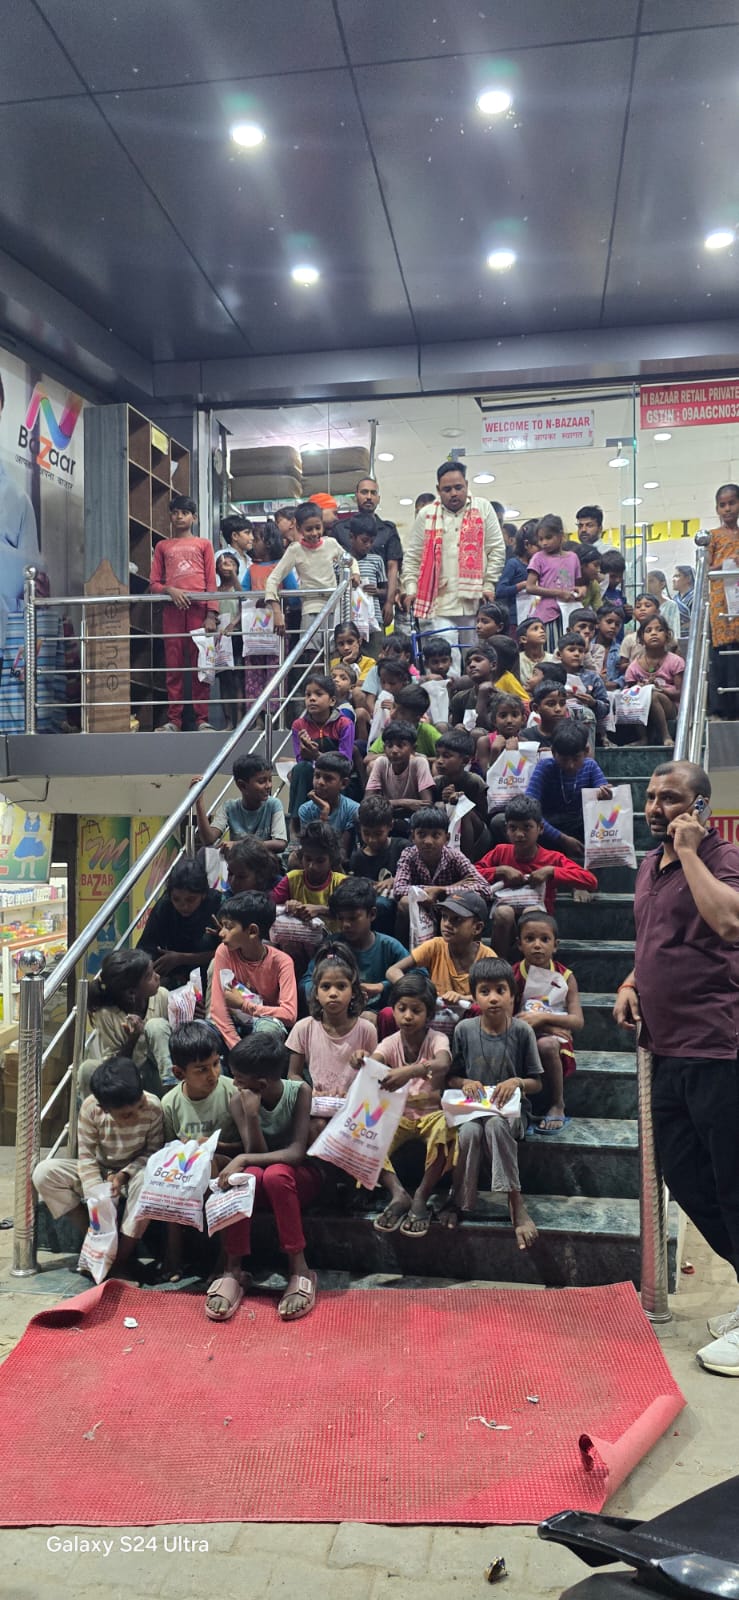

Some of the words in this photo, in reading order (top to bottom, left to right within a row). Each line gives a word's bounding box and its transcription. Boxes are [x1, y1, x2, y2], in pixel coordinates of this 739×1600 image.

[642, 392, 648, 406] N
[650, 390, 679, 405] BAZAAR
[681, 388, 707, 402] RETAIL
[709, 385, 739, 401] PRIVATE
[646, 408, 674, 423] GSTIN
[485, 420, 529, 433] WELCOME
[532, 420, 543, 430] TO
[545, 416, 590, 428] N-BAZAAR
